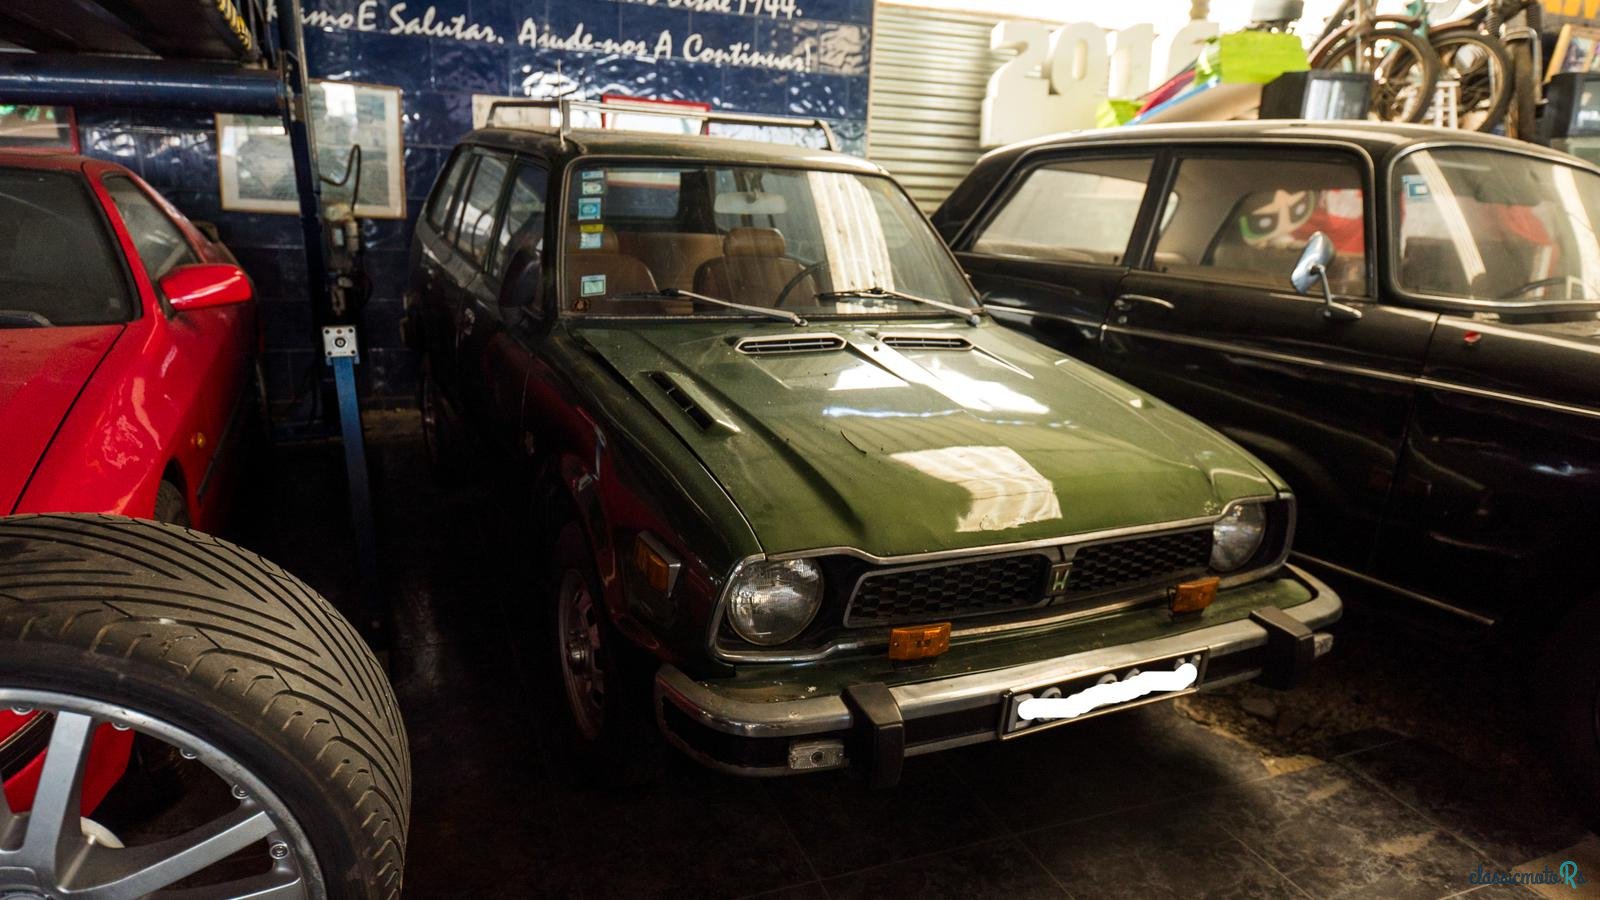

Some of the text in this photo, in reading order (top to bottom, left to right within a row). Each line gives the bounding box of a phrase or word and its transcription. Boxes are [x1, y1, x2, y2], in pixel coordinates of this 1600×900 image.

[737, 0, 802, 20] 1944.
[390, 3, 504, 44] Salutar.
[655, 29, 673, 60] A
[683, 33, 811, 73] Continuar!
